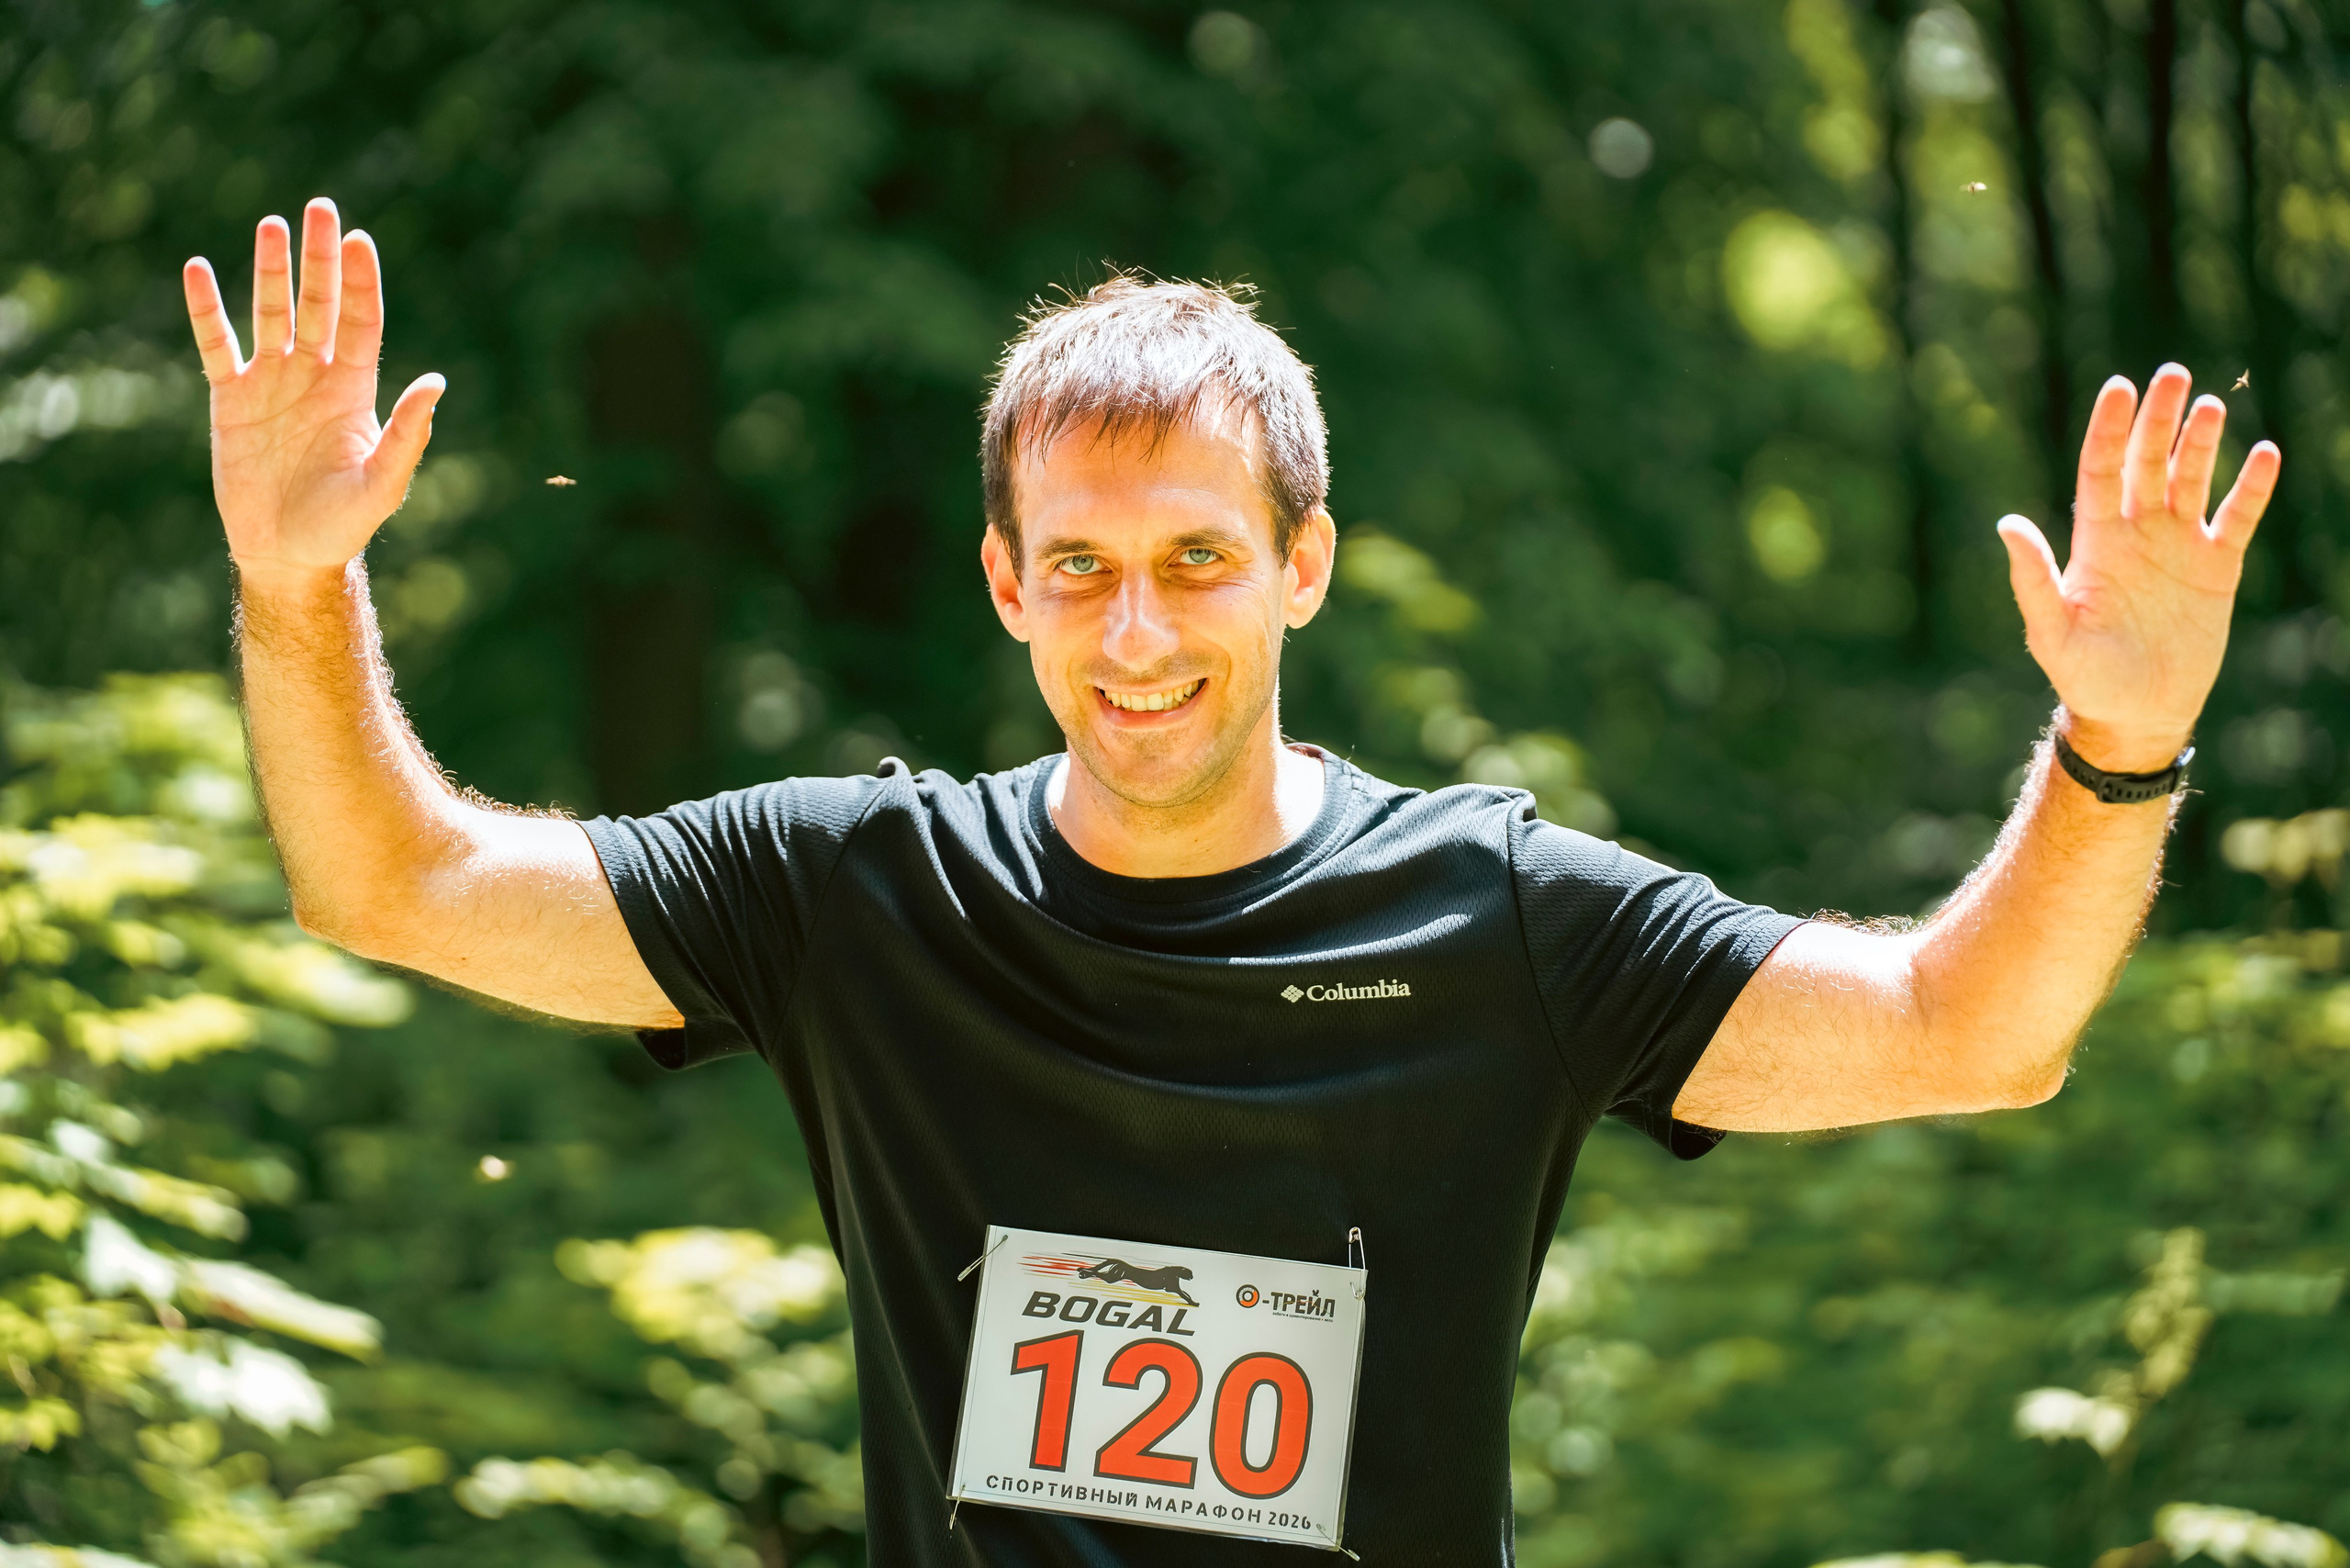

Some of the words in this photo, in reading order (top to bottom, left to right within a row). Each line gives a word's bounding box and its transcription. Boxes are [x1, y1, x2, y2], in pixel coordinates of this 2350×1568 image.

[1306, 979, 1412, 1002] Columbia
[1022, 1290, 1195, 1337] BOGAL
[1010, 1328, 1314, 1500] 120
[986, 1474, 1138, 1507] СПОРТИВНЫЙ
[1145, 1495, 1261, 1524] МАРАФОН
[1268, 1511, 1312, 1530] 2026
